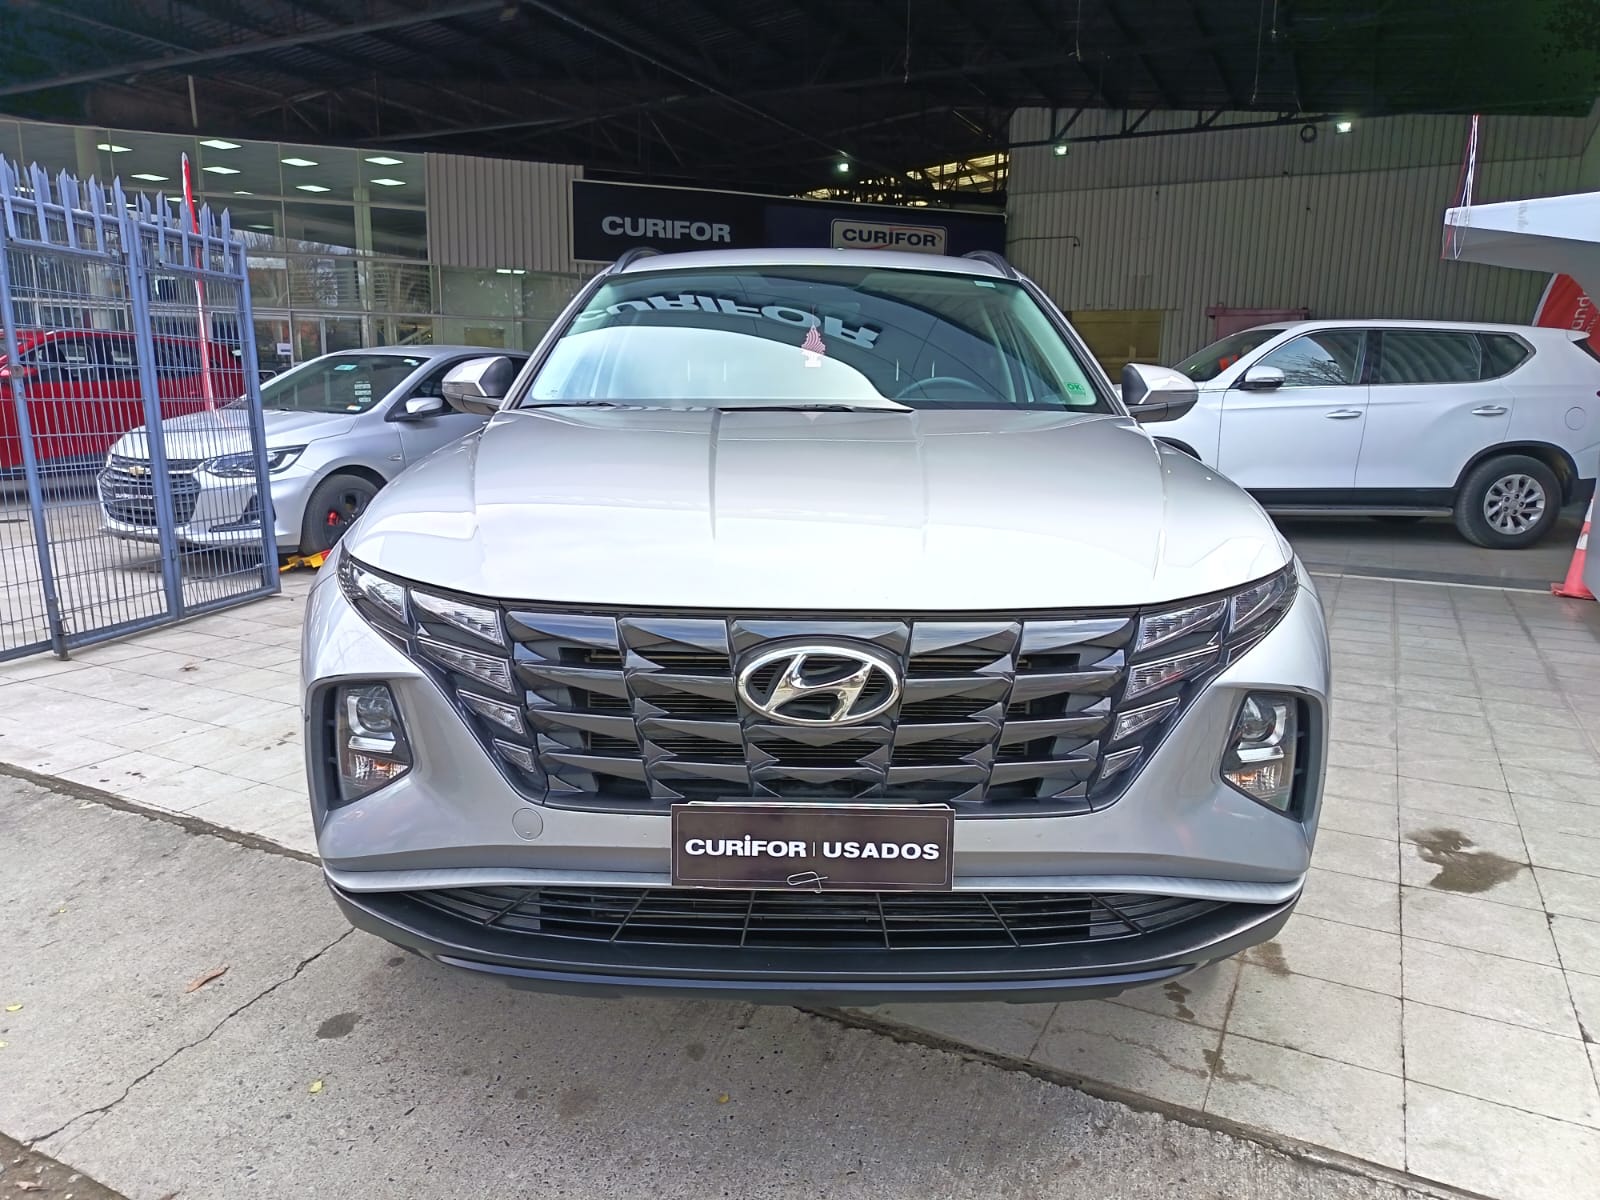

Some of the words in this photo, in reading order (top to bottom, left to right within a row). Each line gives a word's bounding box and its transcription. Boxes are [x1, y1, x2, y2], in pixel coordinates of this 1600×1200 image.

[601, 215, 731, 243] CURIFOR
[842, 228, 937, 247] CURIFOR
[823, 842, 940, 860] USADOS
